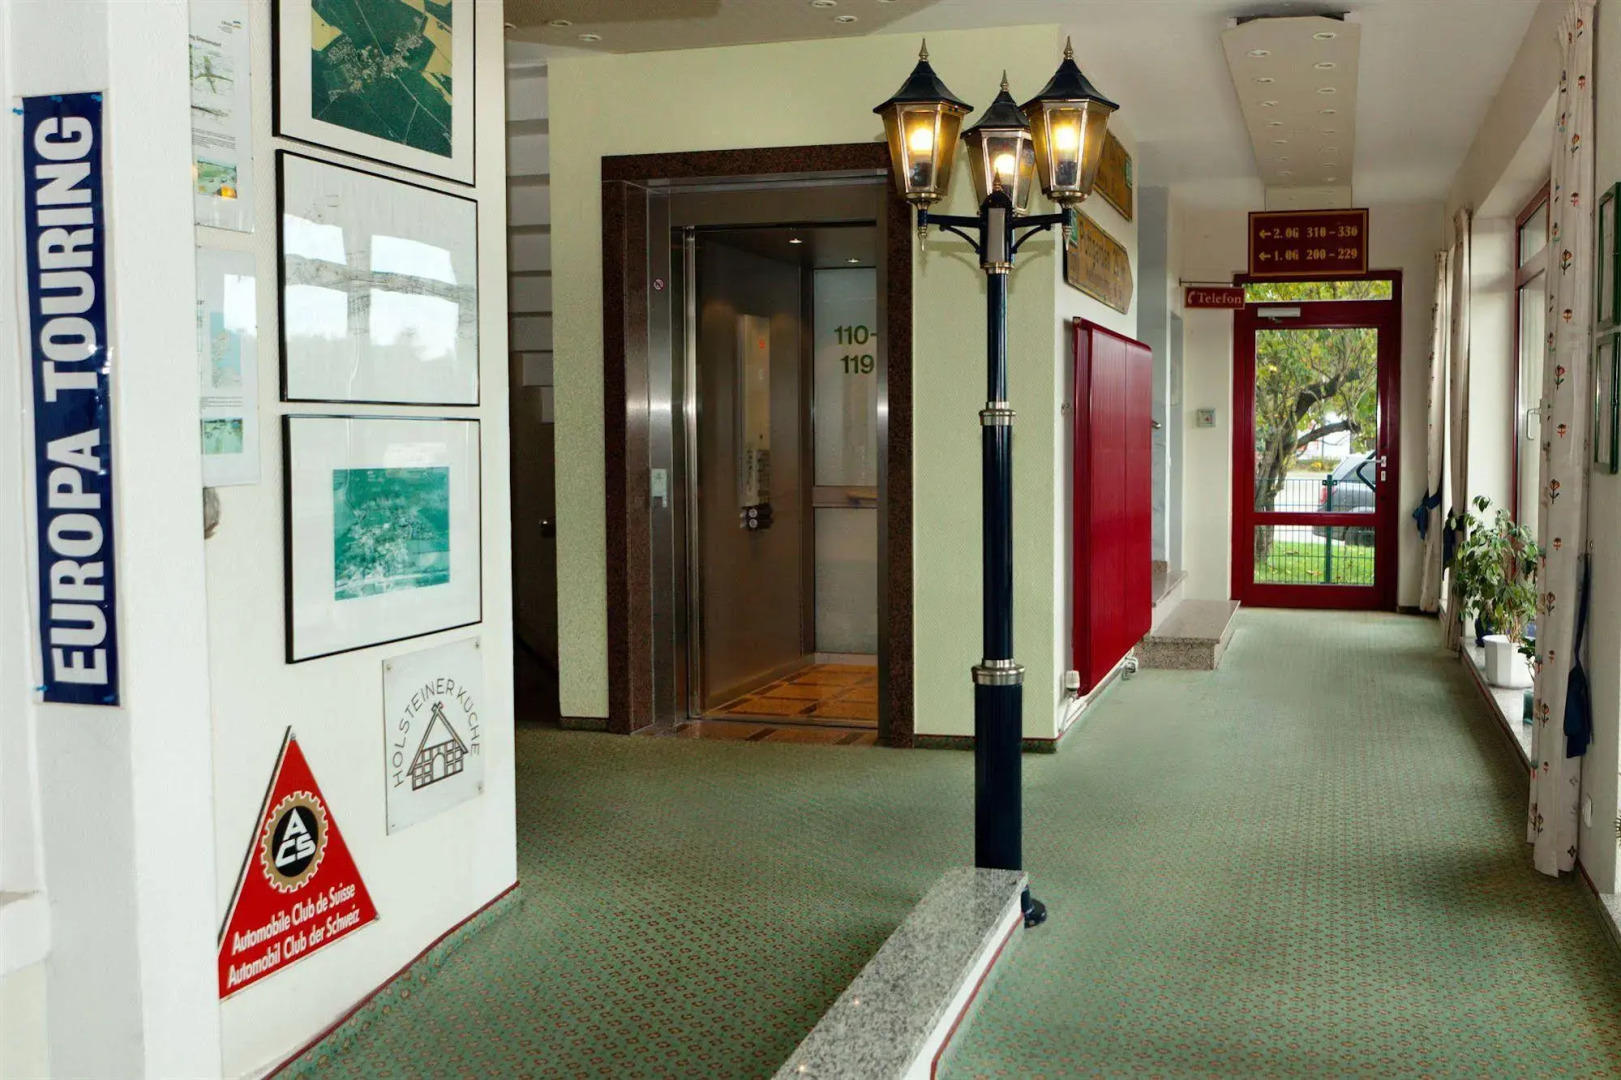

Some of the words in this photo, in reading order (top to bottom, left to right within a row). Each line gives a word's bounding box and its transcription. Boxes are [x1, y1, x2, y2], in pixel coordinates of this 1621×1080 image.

[34, 116, 99, 403] TOURING
[1197, 291, 1242, 304] Telefon
[840, 354, 875, 374] 119
[47, 428, 108, 685] EUROPA
[393, 678, 455, 788] HOLSTEINER
[227, 942, 281, 989] Automobil
[283, 931, 307, 959] Club
[309, 924, 325, 947] der
[326, 904, 360, 938] Schweiz
[232, 910, 291, 956] Automobile
[292, 898, 315, 926] Club
[316, 892, 328, 915] de
[329, 883, 355, 908] Suisse
